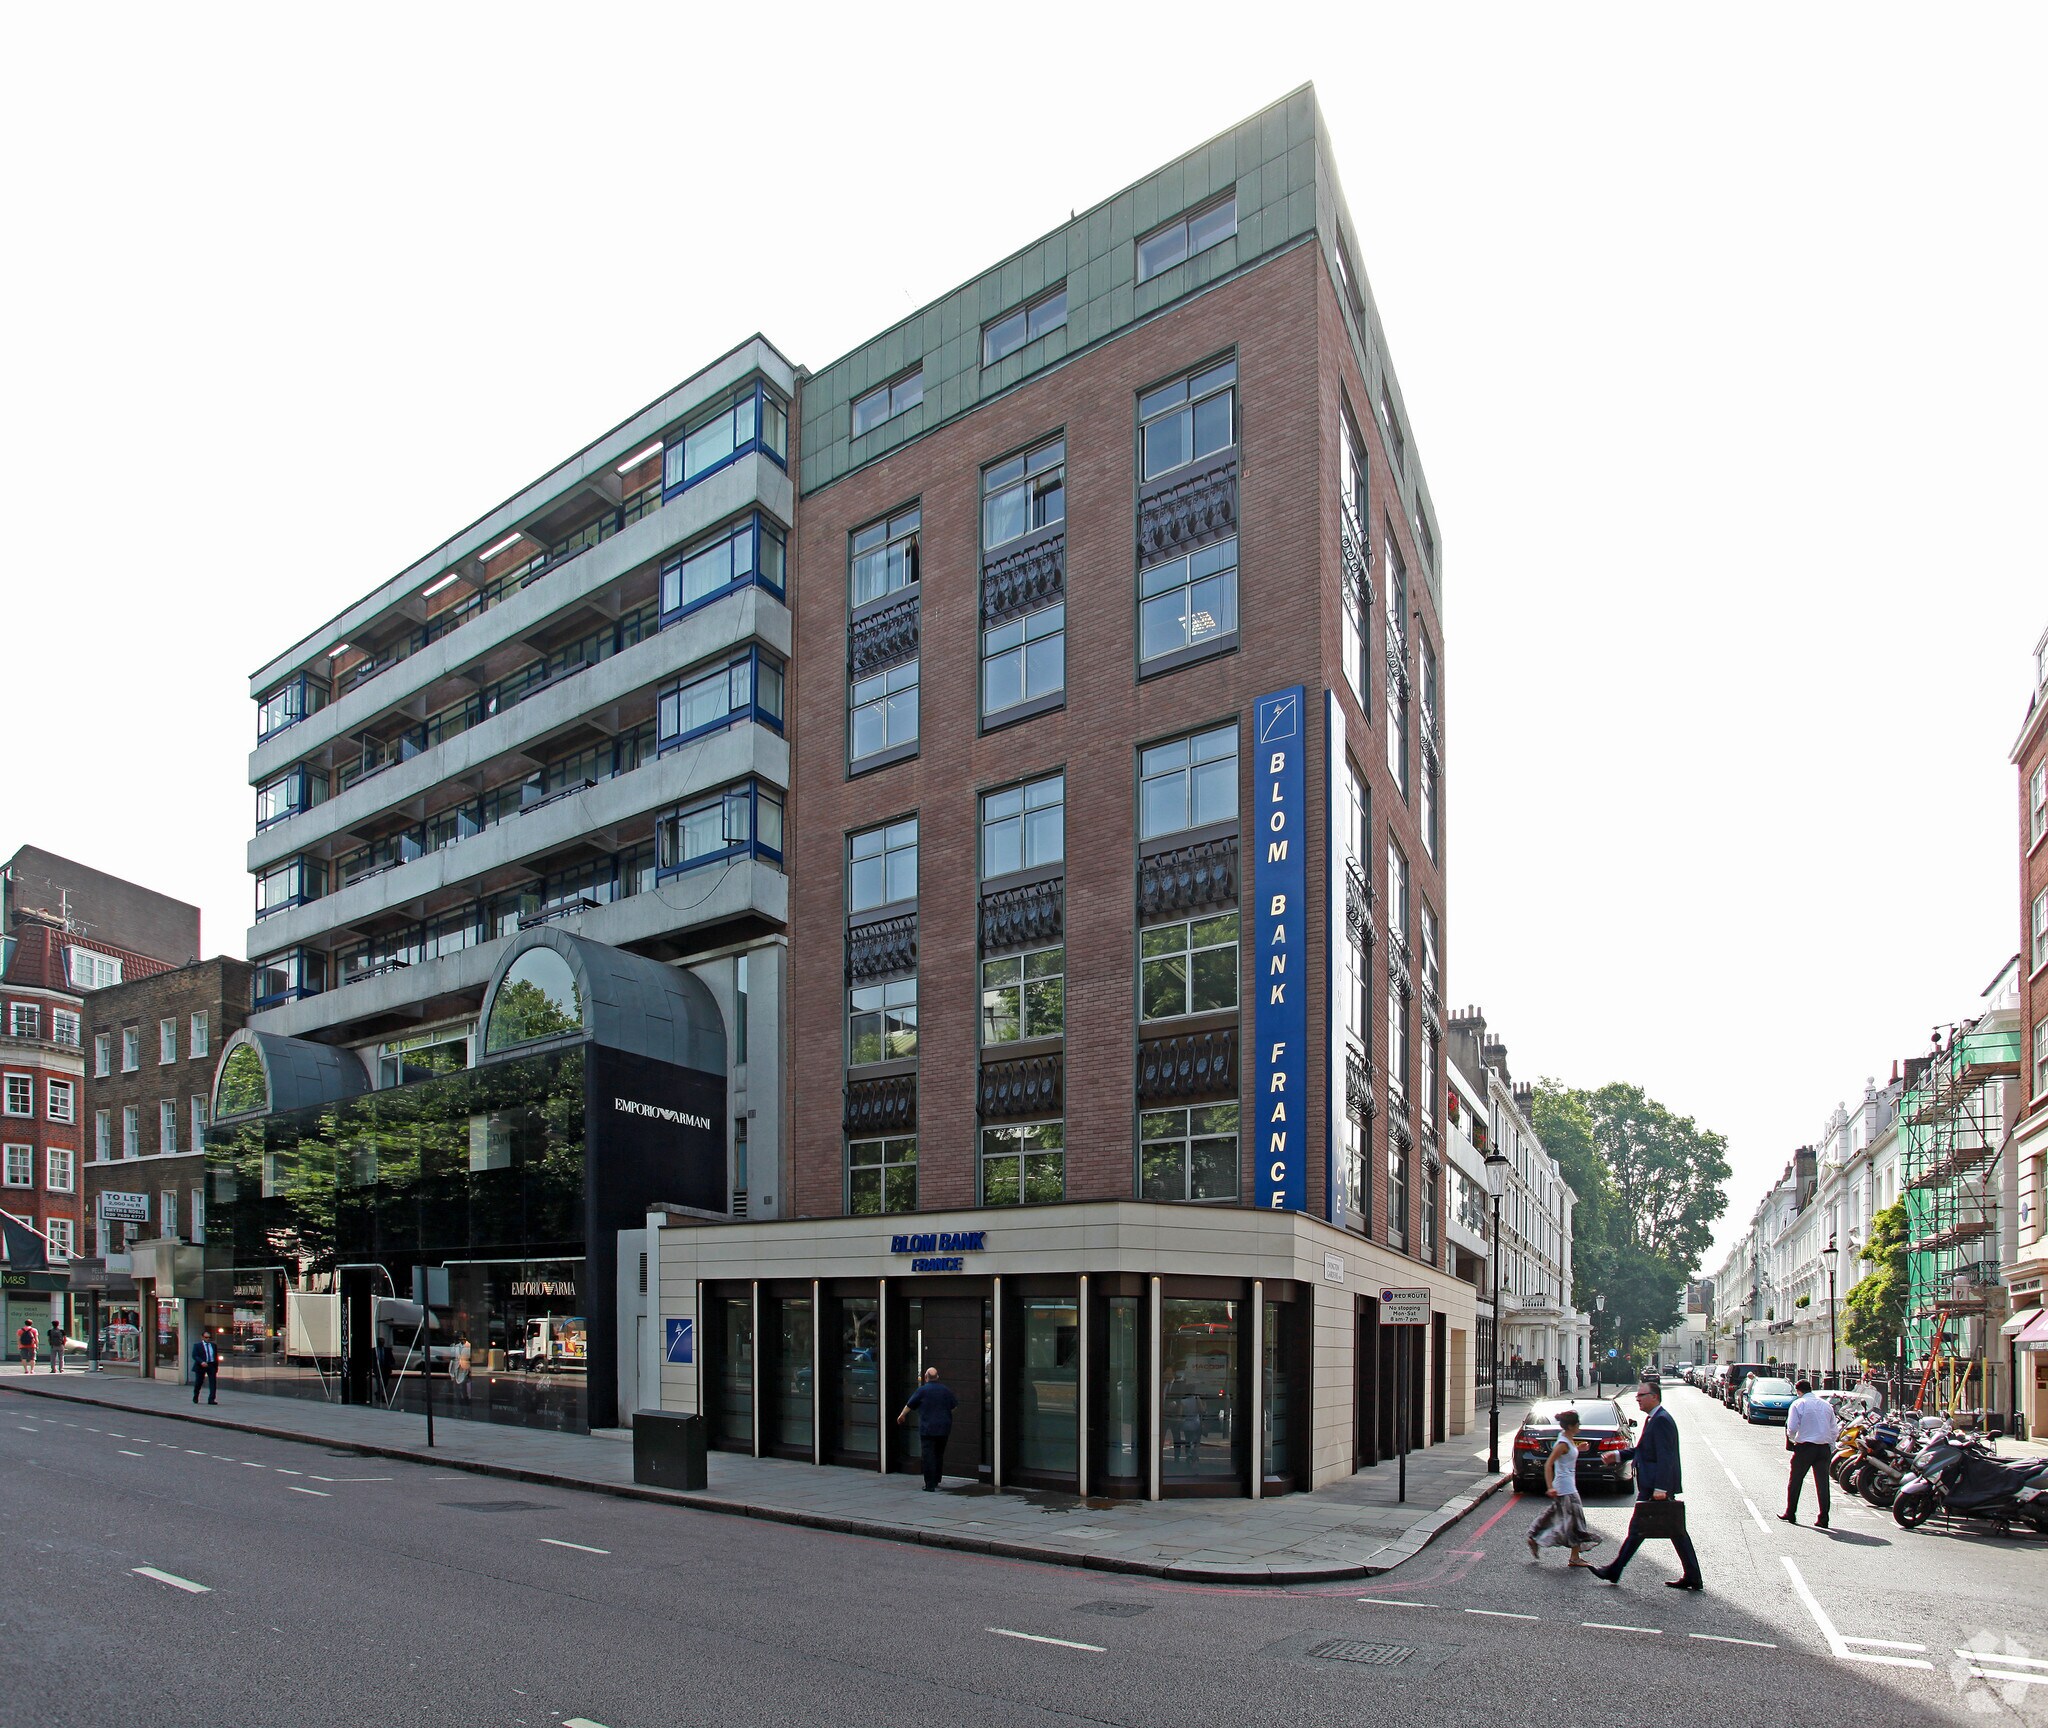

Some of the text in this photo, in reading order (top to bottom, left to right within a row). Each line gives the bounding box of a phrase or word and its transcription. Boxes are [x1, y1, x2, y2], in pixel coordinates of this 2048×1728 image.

[1267, 752, 1289, 1209] BLOM BANK FRANCE
[614, 1097, 711, 1130] EMPORIO ARMANI
[105, 1193, 120, 1201] TO
[890, 1231, 986, 1253] BLOM BANK
[911, 1257, 964, 1272] FRANCE
[2, 1275, 26, 1285] M&S
[511, 1281, 576, 1296] EMPORIO ARMA
[341, 1303, 349, 1378] EMPORIO ARMANI
